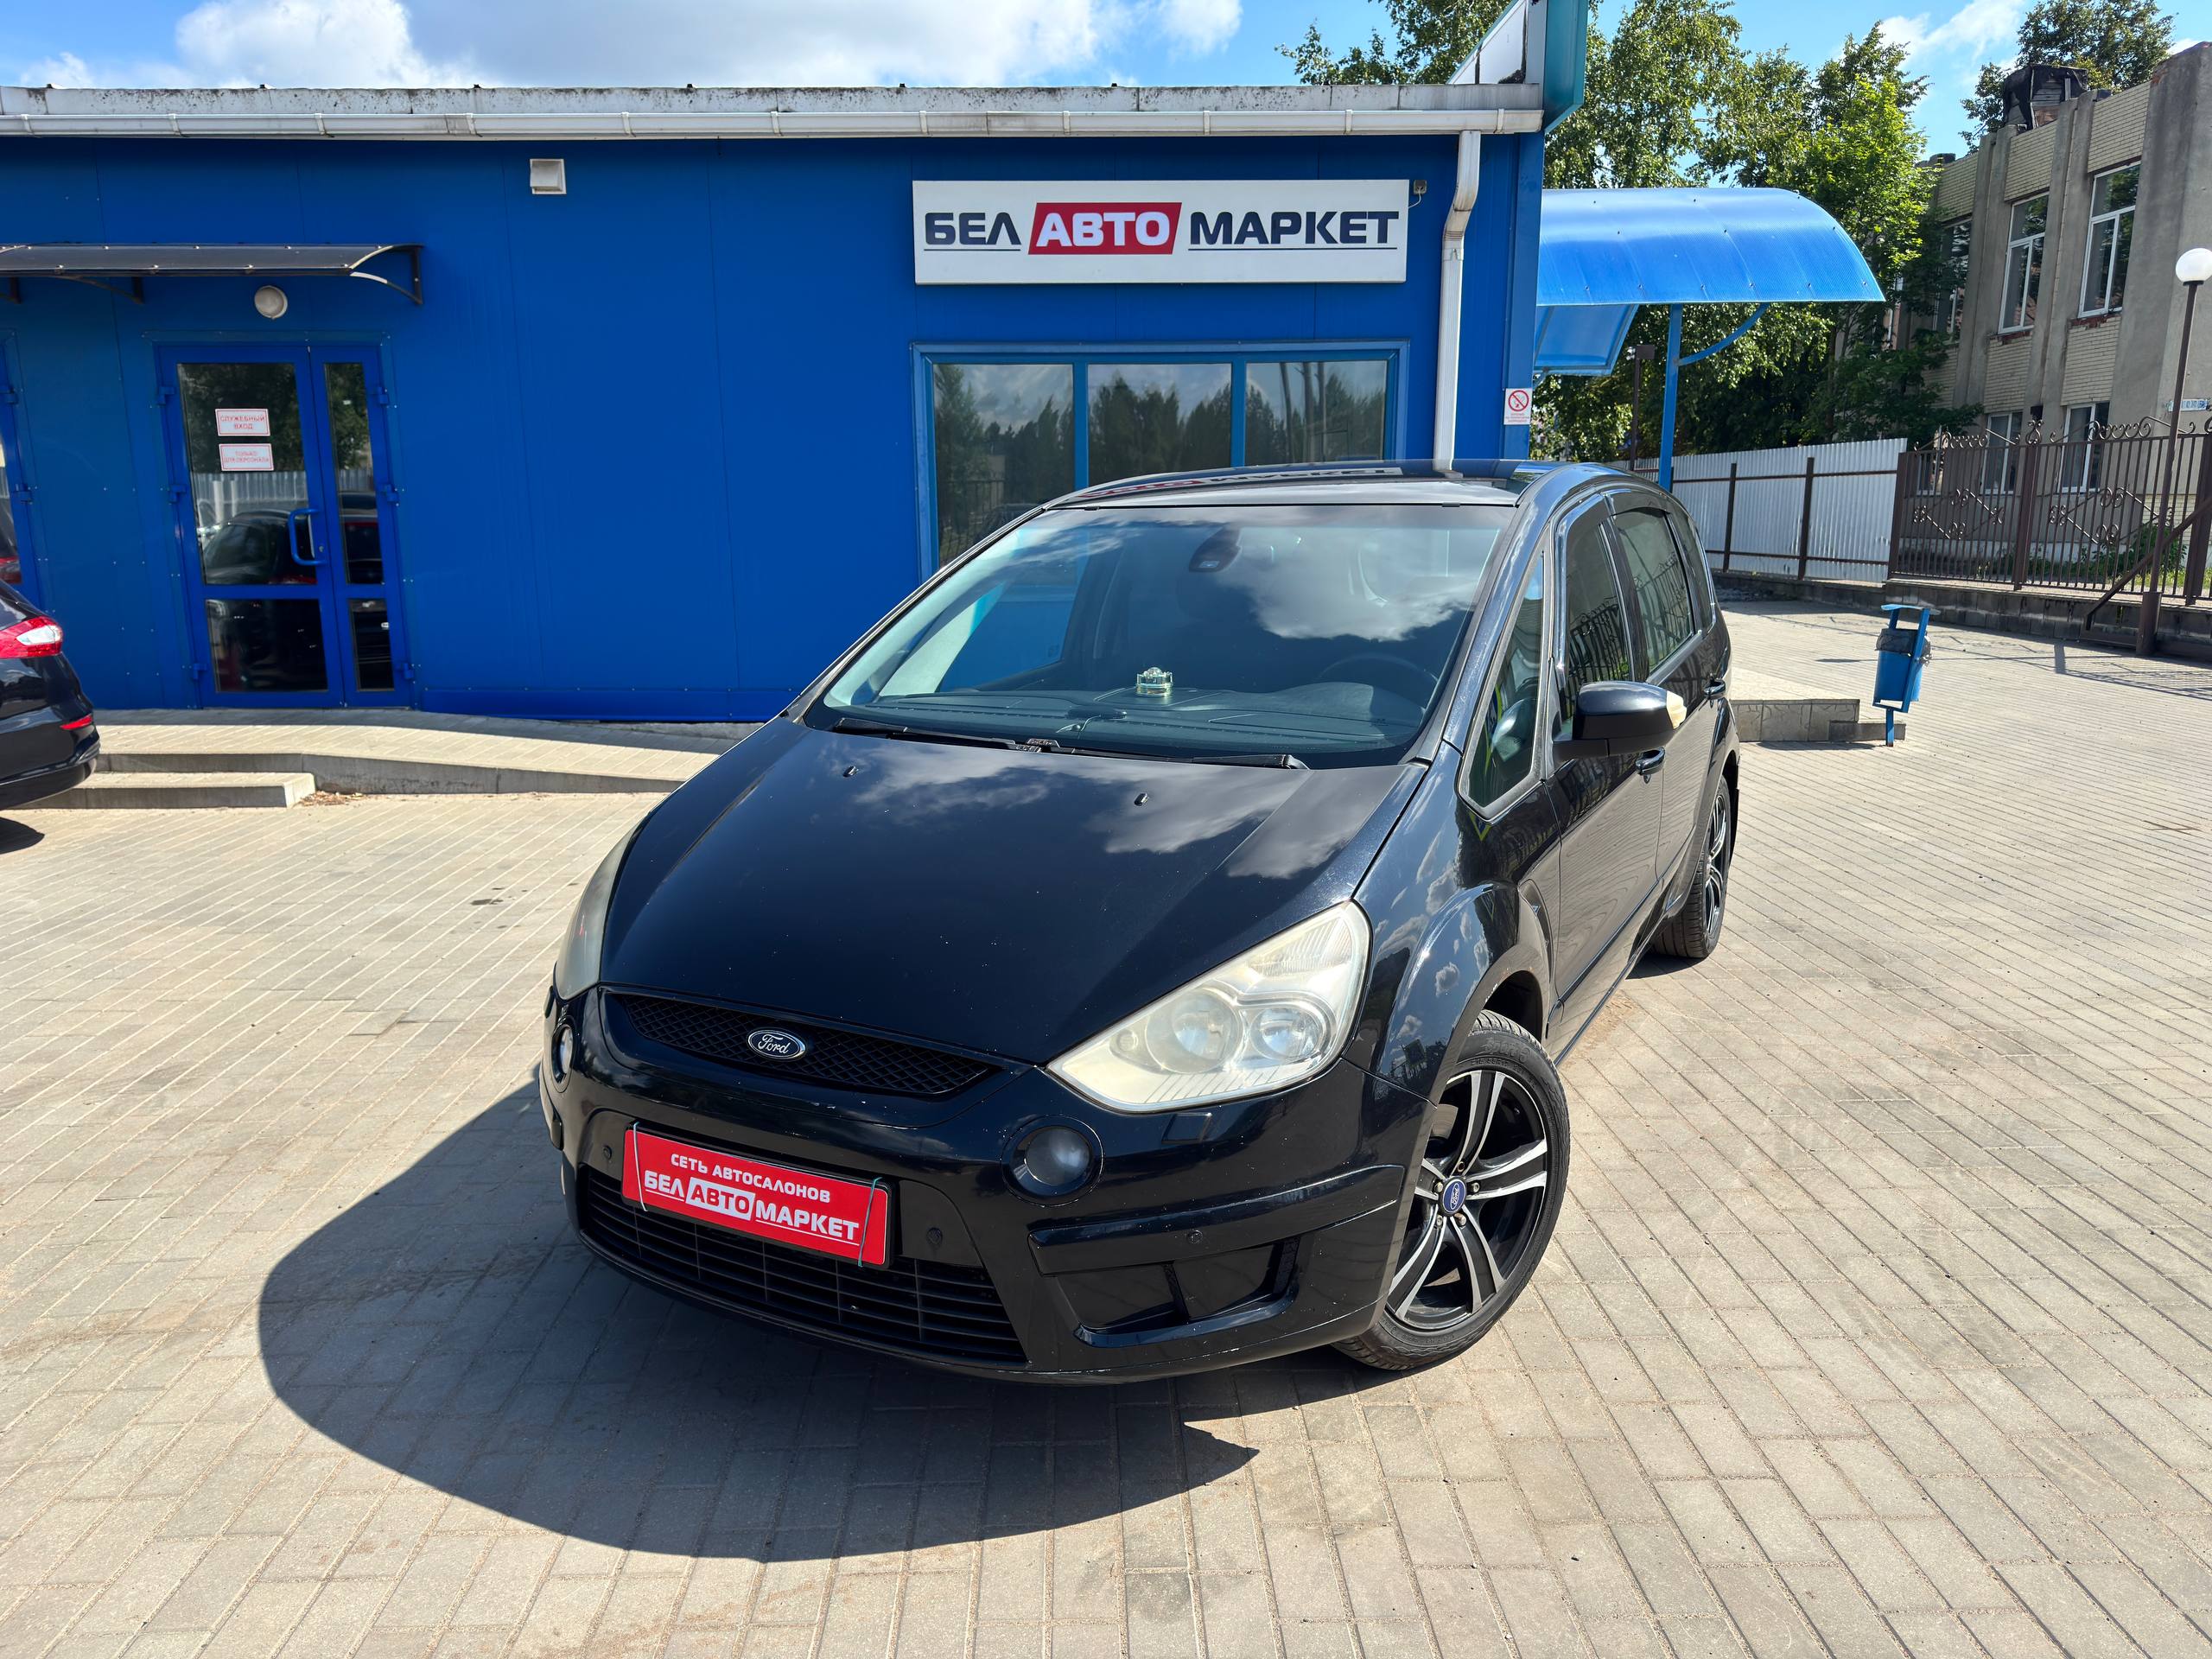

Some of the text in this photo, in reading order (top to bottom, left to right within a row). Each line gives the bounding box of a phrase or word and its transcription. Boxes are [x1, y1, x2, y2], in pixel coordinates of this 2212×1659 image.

[924, 211, 1400, 247] БЕЛ АВТО МАРКЕТ
[758, 1034, 791, 1054] Ford
[671, 1154, 831, 1203] СЕТЬ АВТОСАЛОНОВ
[645, 1170, 860, 1241] БЕЛ АВТО МАРКЕТ
